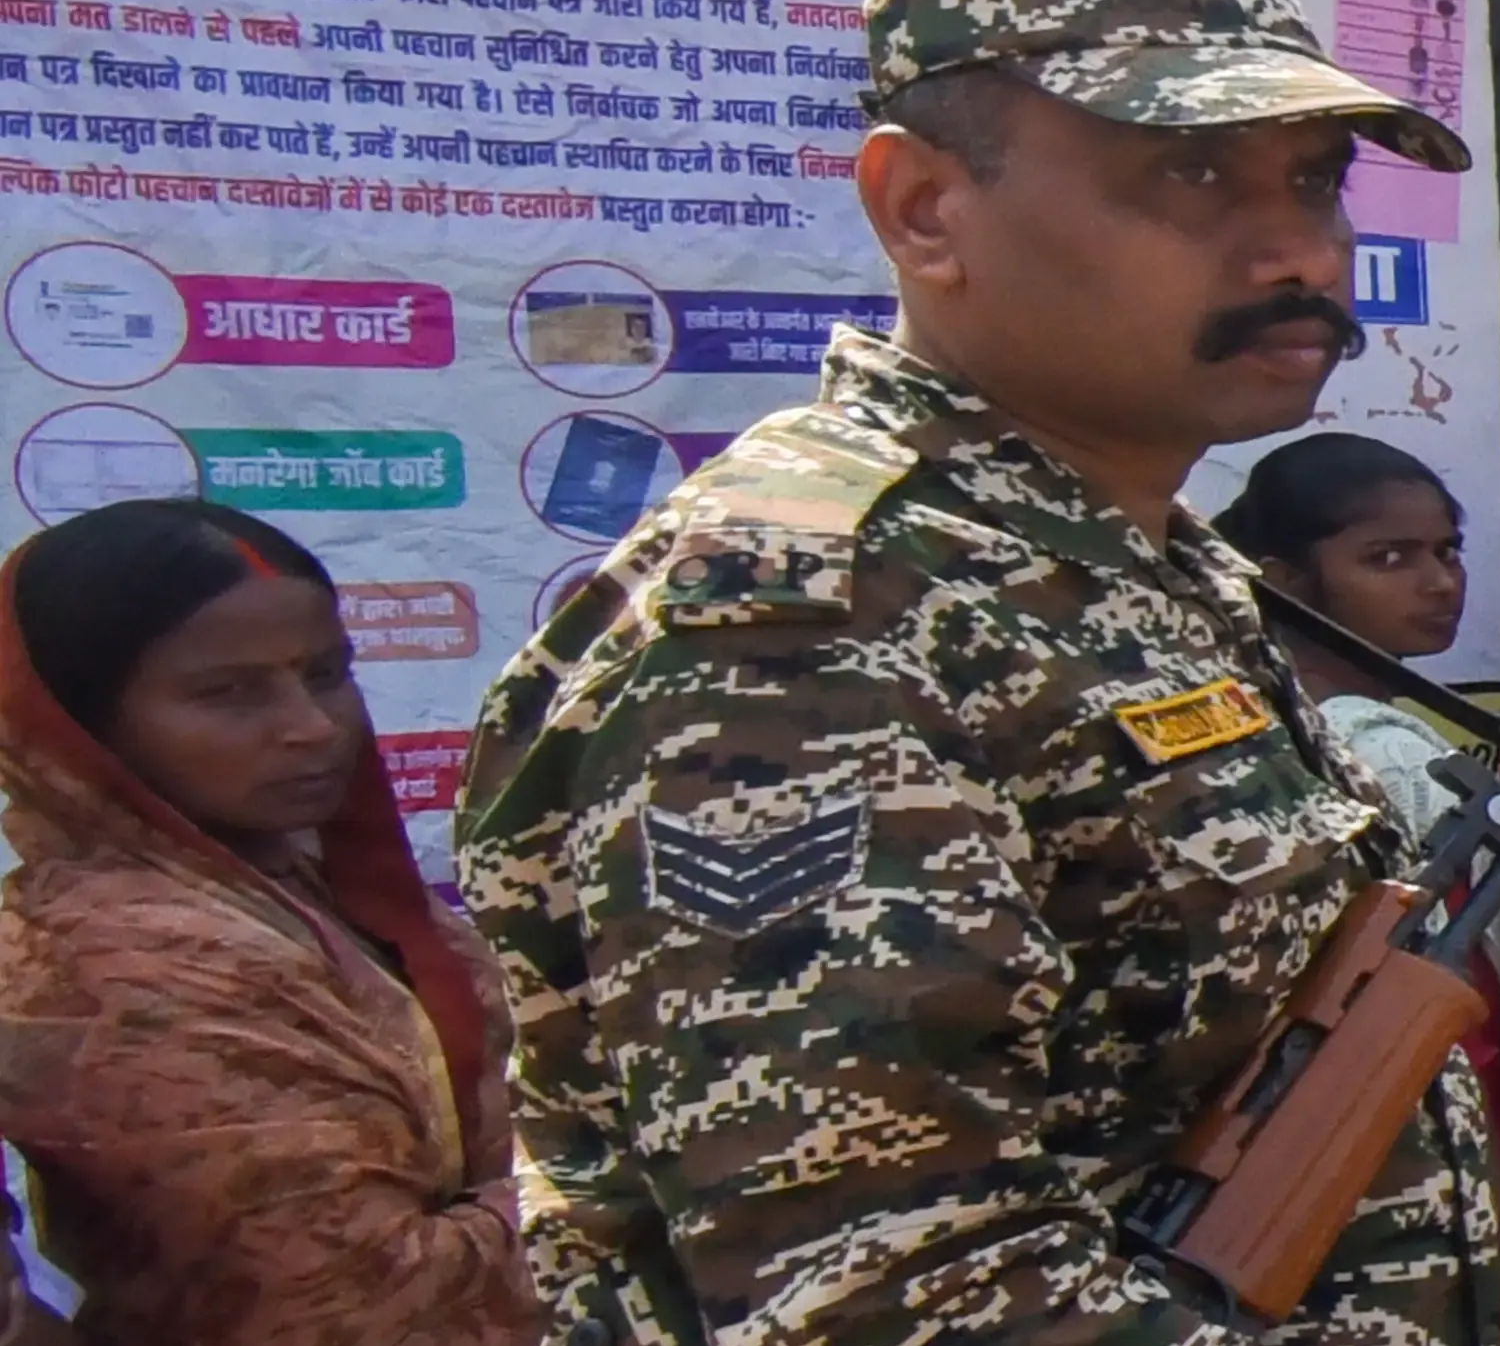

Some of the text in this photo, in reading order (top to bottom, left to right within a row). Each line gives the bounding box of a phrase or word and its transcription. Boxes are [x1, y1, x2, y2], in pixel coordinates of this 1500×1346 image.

[66, 1, 112, 31] मत
[121, 5, 196, 41] डालने
[203, 7, 231, 45] से
[240, 6, 303, 50] पहले
[312, 19, 384, 54] अपनी
[391, 29, 474, 61] पहचान
[484, 29, 589, 72] सुनिश्चित
[596, 37, 659, 72] करने
[669, 39, 703, 81] हेतु
[710, 46, 777, 77] अपना
[784, 44, 871, 82] निर्वाचक
[785, 1, 866, 32] मतदान
[38, 53, 80, 85] पत्र
[89, 49, 182, 92] दिखाने
[190, 64, 227, 96] का
[237, 68, 331, 104] प्रावधान
[341, 68, 405, 107] किया
[413, 82, 464, 114] गया
[513, 83, 555, 119] ऐसे
[564, 84, 660, 125] निर्वाचक
[669, 94, 701, 125] जो
[710, 97, 777, 128] अपना
[37, 112, 79, 142] पत्र
[83, 113, 156, 154] प्रस्तुत
[159, 113, 216, 149] नहीं
[217, 122, 262, 153] कर
[263, 120, 310, 156] पाते
[344, 124, 398, 159] उन्हें
[402, 130, 471, 166] अपनी
[474, 138, 559, 169] पहचान
[562, 137, 649, 174] स्थापित
[656, 143, 713, 177] करने
[718, 143, 742, 177] के
[746, 143, 793, 180] लिए
[0, 157, 60, 196] ल्पिक
[66, 164, 127, 202] फोटो
[132, 171, 217, 204] पहचान
[223, 172, 333, 213] दस्तावेजों
[336, 176, 363, 213] में
[366, 176, 394, 214] से
[398, 180, 447, 219] कोई
[452, 189, 494, 219] एक
[499, 184, 594, 222] दस्तावेज
[598, 195, 663, 232] प्रस्तुत
[669, 200, 737, 228] करना
[203, 295, 415, 344] आधार कार्ड
[206, 447, 447, 488] मनरेगा जॉब कार्ड
